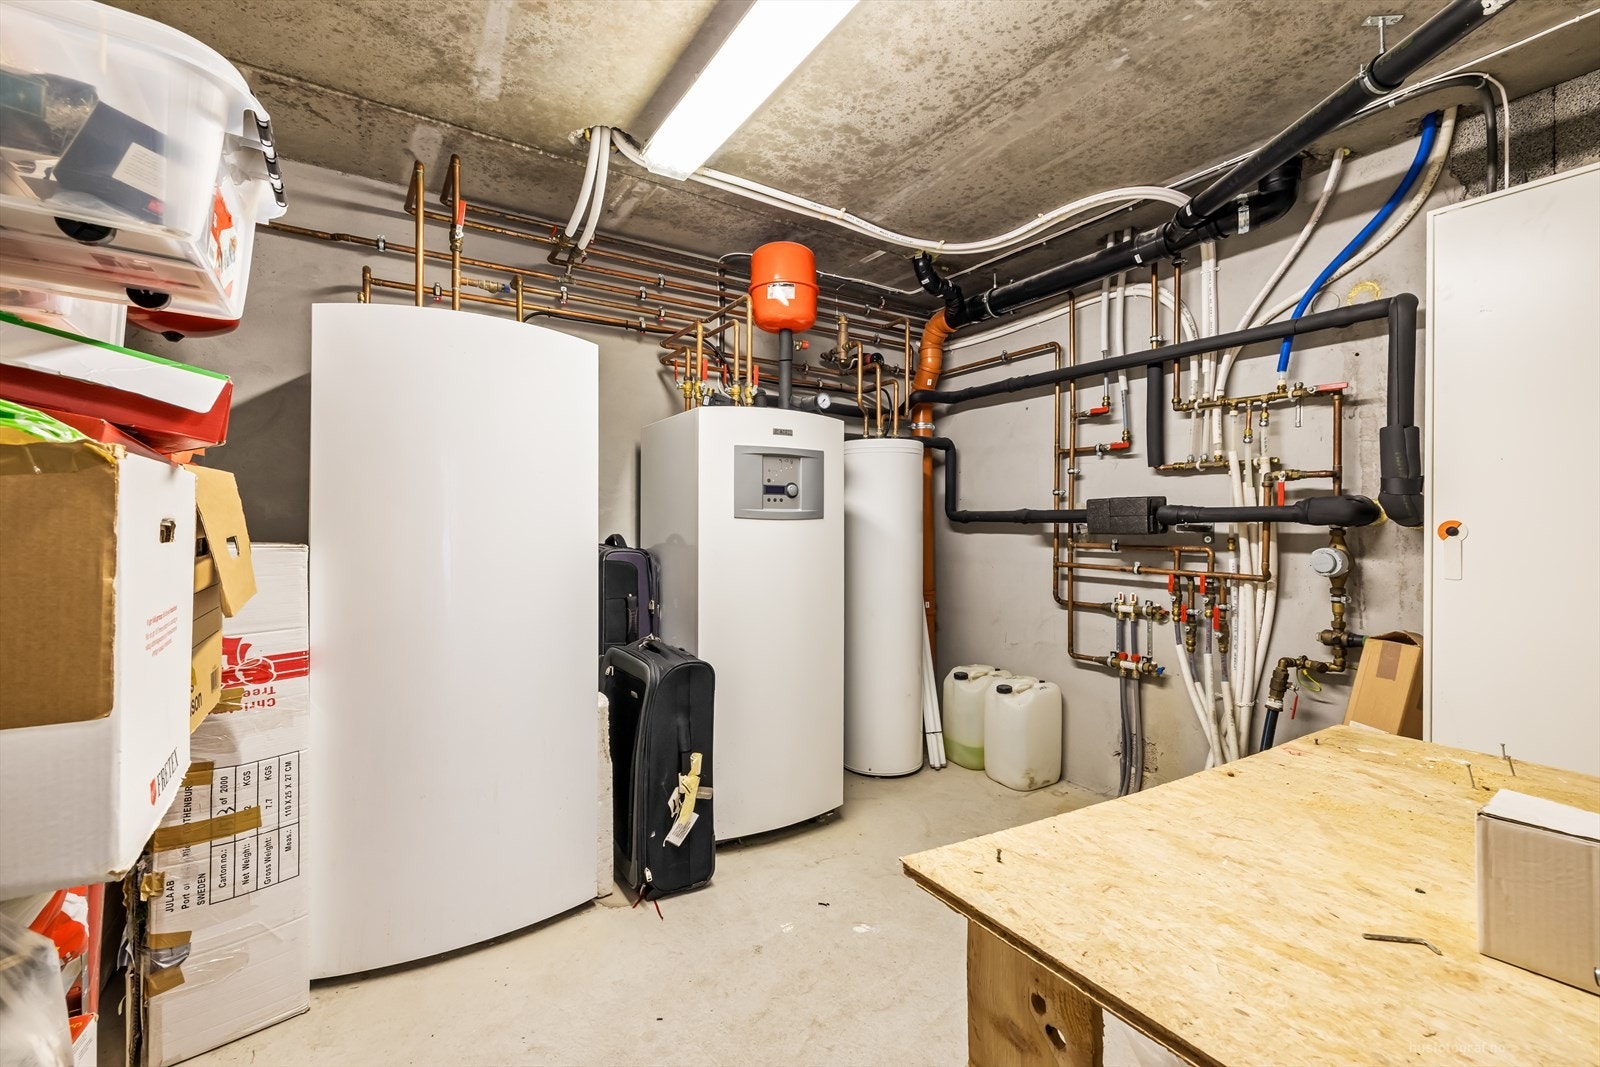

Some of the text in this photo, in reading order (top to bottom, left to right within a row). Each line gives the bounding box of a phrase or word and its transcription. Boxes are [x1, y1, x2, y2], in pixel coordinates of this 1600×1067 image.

[242, 686, 276, 698] Tree
[190, 692, 203, 717] son
[241, 697, 276, 711] Chri
[285, 760, 293, 772] CM
[242, 770, 252, 787] KGS
[264, 765, 273, 809] 7.7 KGS
[285, 773, 293, 782] 27
[219, 775, 229, 805] of 2000
[263, 836, 274, 885] Gross Weight:
[218, 863, 228, 889] Carton
[241, 871, 250, 885] Net
[166, 880, 174, 913] JULA AB
[197, 873, 207, 906] SWEDEN
[181, 893, 191, 910] Port
